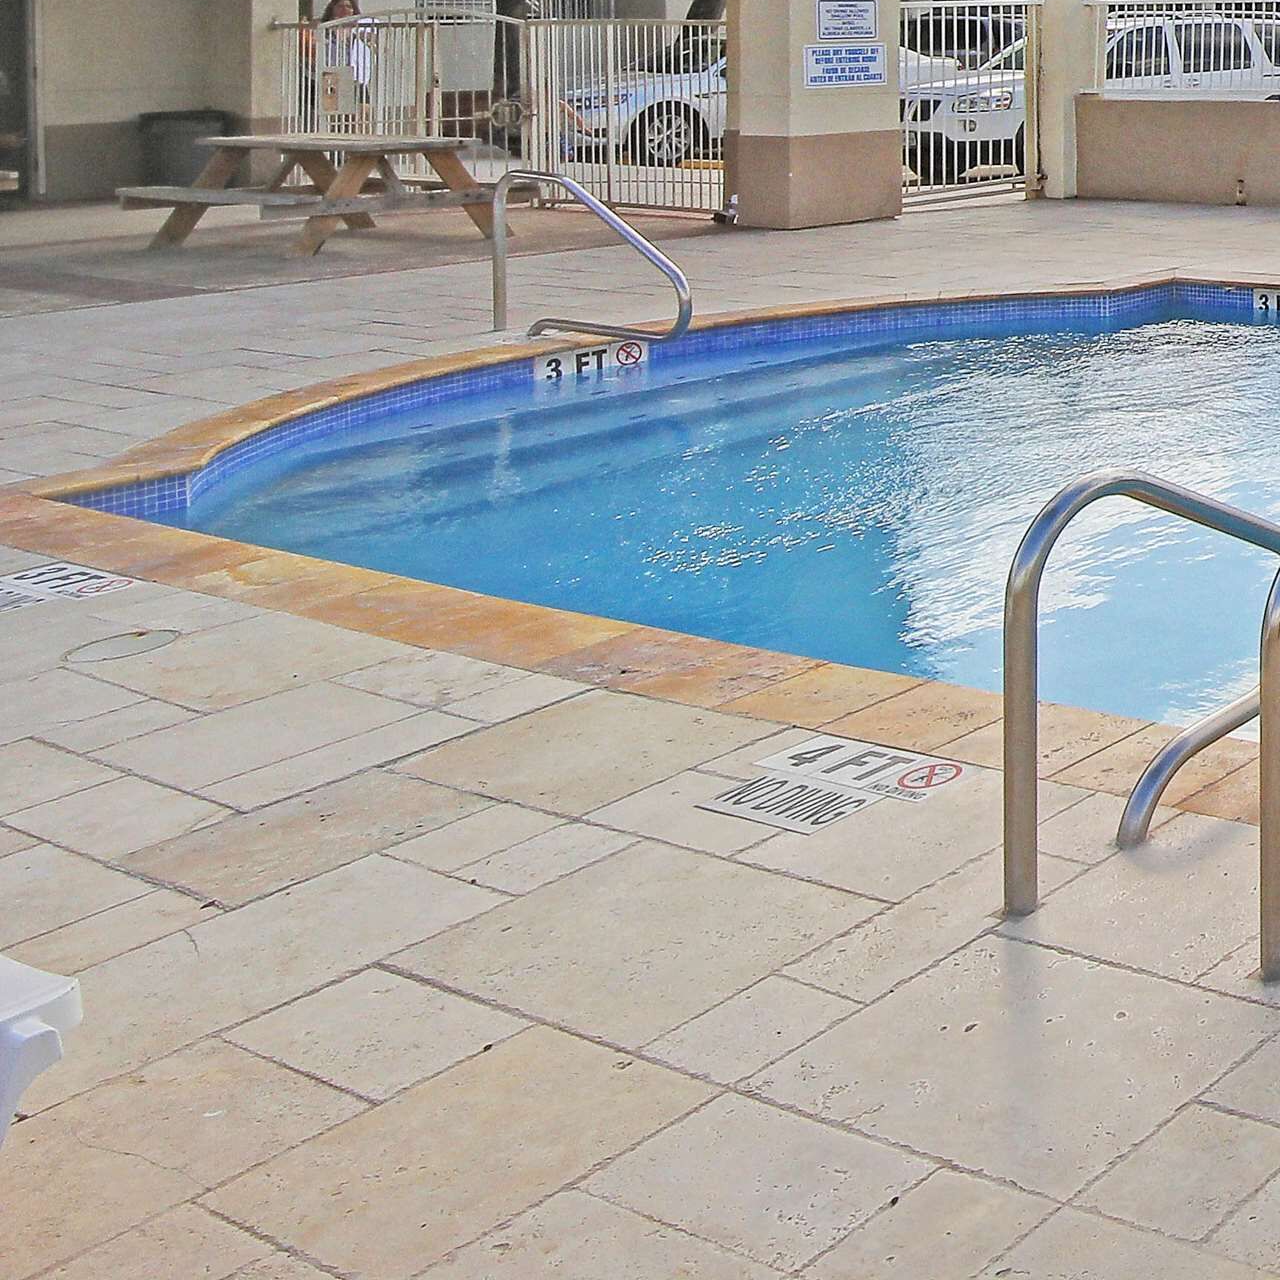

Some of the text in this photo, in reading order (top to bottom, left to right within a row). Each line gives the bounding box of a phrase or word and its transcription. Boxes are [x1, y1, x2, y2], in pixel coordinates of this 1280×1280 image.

[1259, 294, 1269, 310] 3
[546, 349, 607, 379] 3 FT
[31, 571, 107, 589] FT
[787, 744, 917, 781] 4 FT
[714, 776, 867, 825] NO DIVING
